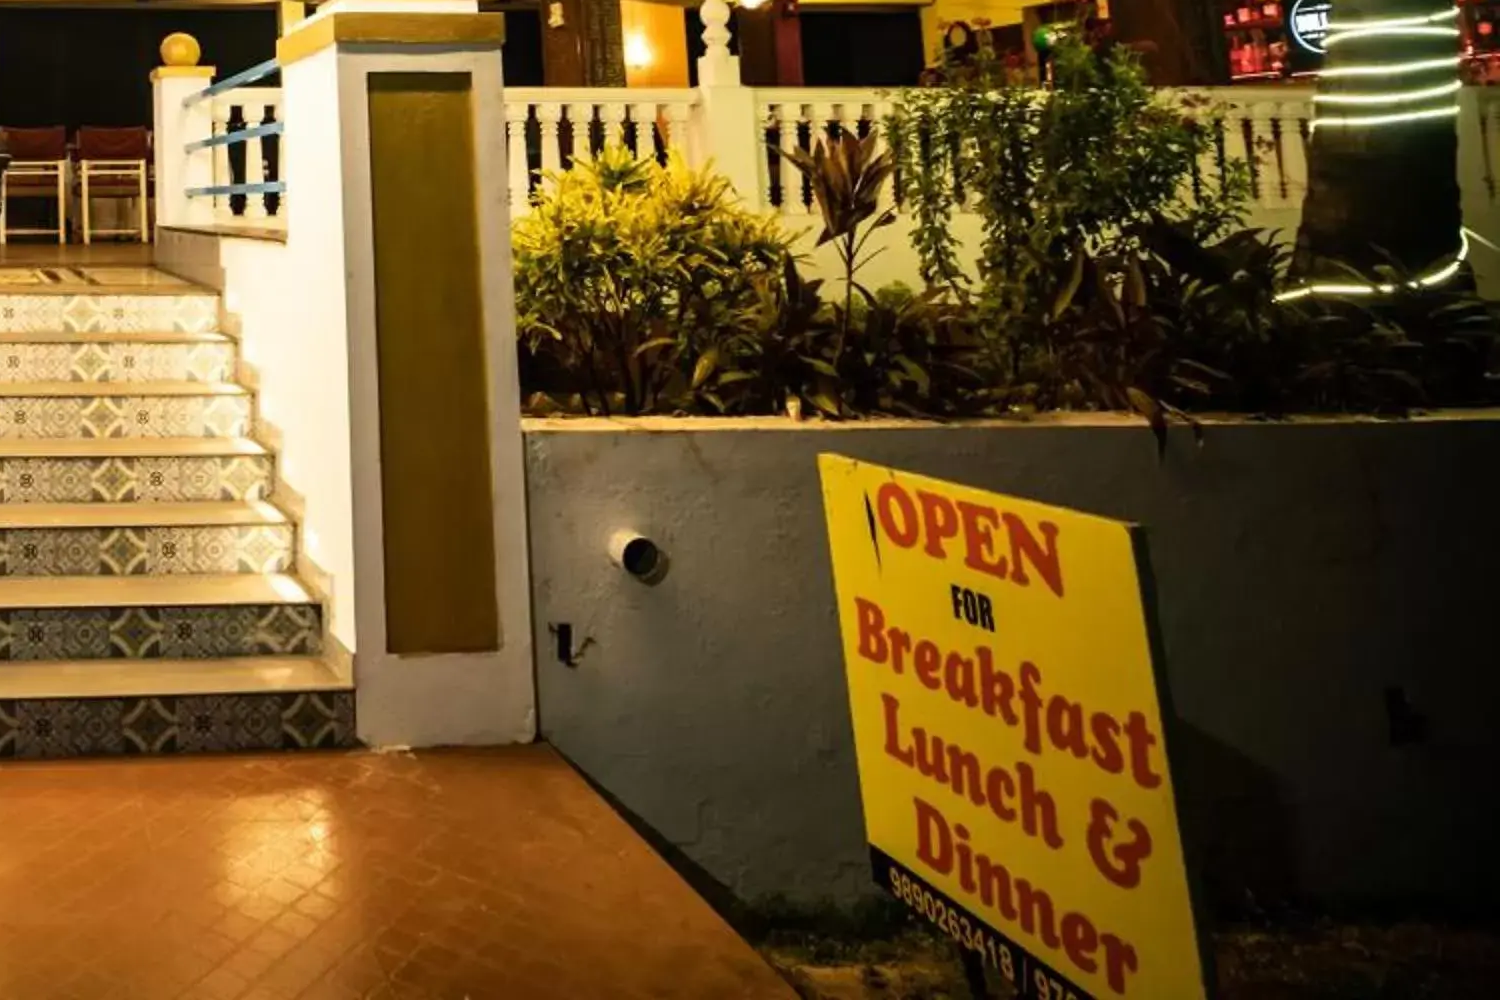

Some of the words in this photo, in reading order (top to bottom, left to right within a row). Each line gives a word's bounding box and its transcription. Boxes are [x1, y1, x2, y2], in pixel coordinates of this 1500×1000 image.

[877, 482, 1064, 598] OPEN
[951, 583, 996, 632] FOR
[855, 597, 1161, 789] Breakfast
[881, 693, 1063, 850] Lunch
[1087, 799, 1152, 889] &
[913, 797, 1138, 995] Dinner
[1033, 967, 1077, 1000] 97
